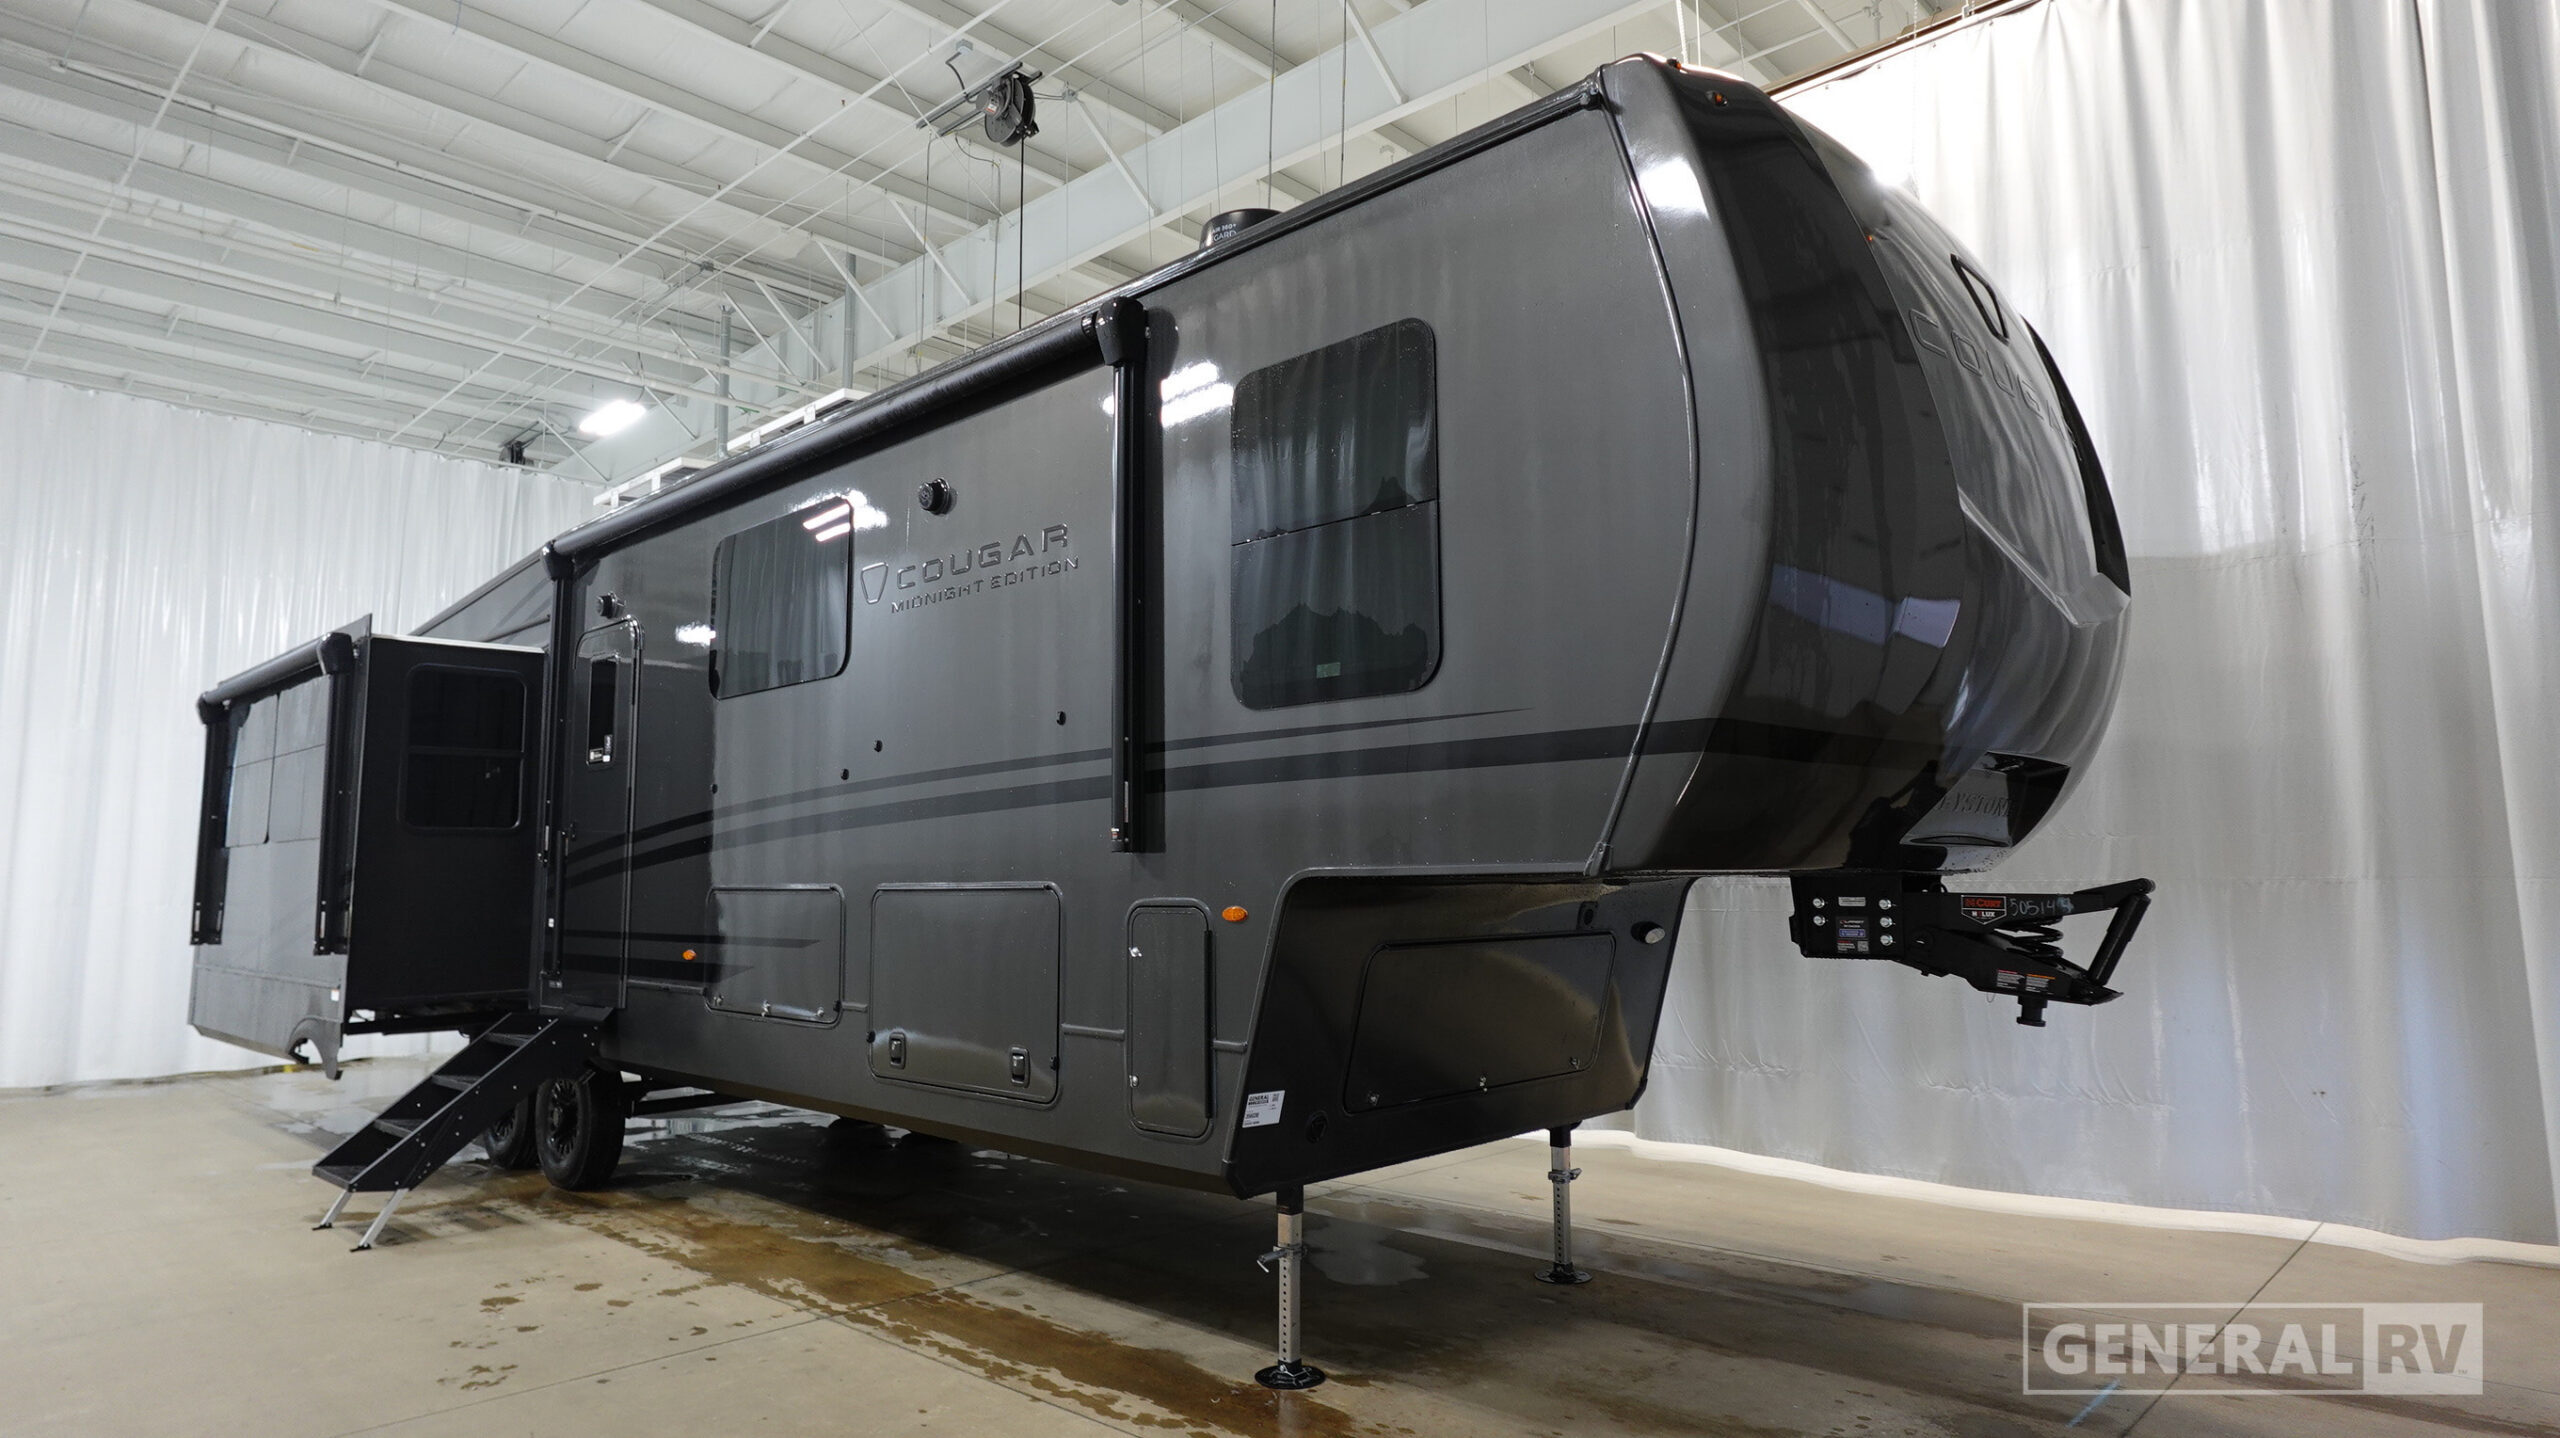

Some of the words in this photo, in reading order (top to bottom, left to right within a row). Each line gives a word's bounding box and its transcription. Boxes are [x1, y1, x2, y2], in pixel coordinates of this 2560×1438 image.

[891, 578, 985, 614] MIDNIGHT
[990, 555, 1080, 589] EDITION
[896, 522, 1068, 590] COUGAR
